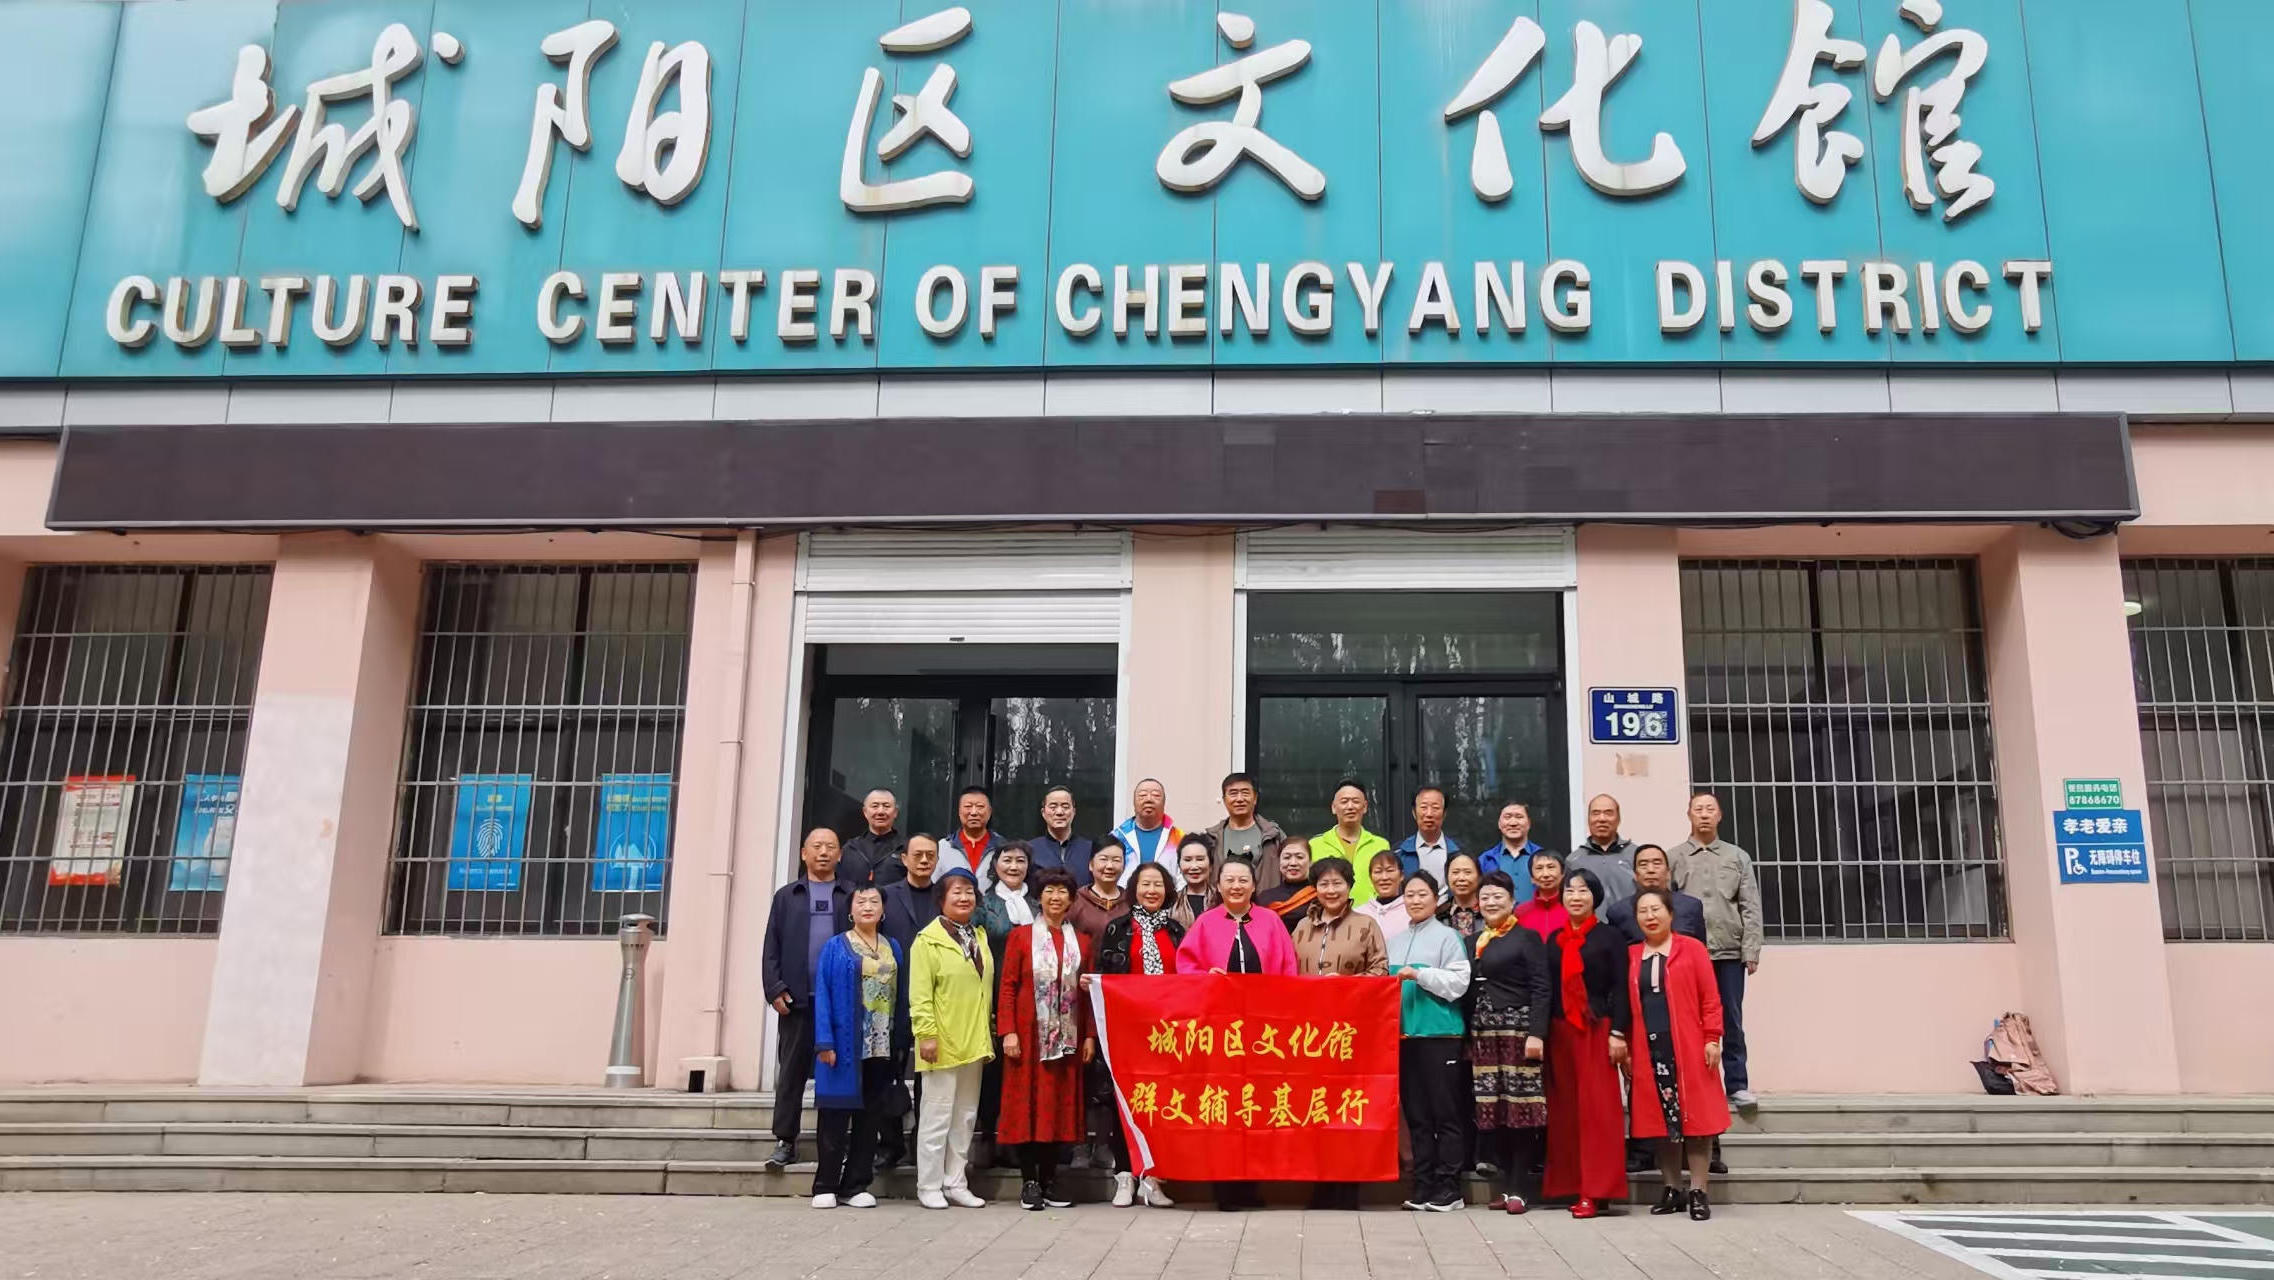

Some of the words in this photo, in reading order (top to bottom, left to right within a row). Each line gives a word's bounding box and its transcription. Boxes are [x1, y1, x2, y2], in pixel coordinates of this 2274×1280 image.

[187, 0, 1997, 231] 城阳区文化馆
[105, 273, 480, 349] CULTURE
[536, 268, 878, 346] CENTER
[914, 263, 1020, 342] OF
[1055, 259, 1593, 340] CHENGYANG
[1655, 258, 2053, 337] DISTRICT
[1603, 692, 1664, 704] 山城路
[1605, 711, 1663, 737] 196
[2069, 795, 2120, 805] 87868670
[2063, 818, 2128, 834] 孝老爱亲
[2088, 848, 2142, 866] 无障碍停车位
[1146, 1019, 1359, 1063] 城阳区文化馆
[1129, 1082, 1370, 1128] 群文辅导基层行
